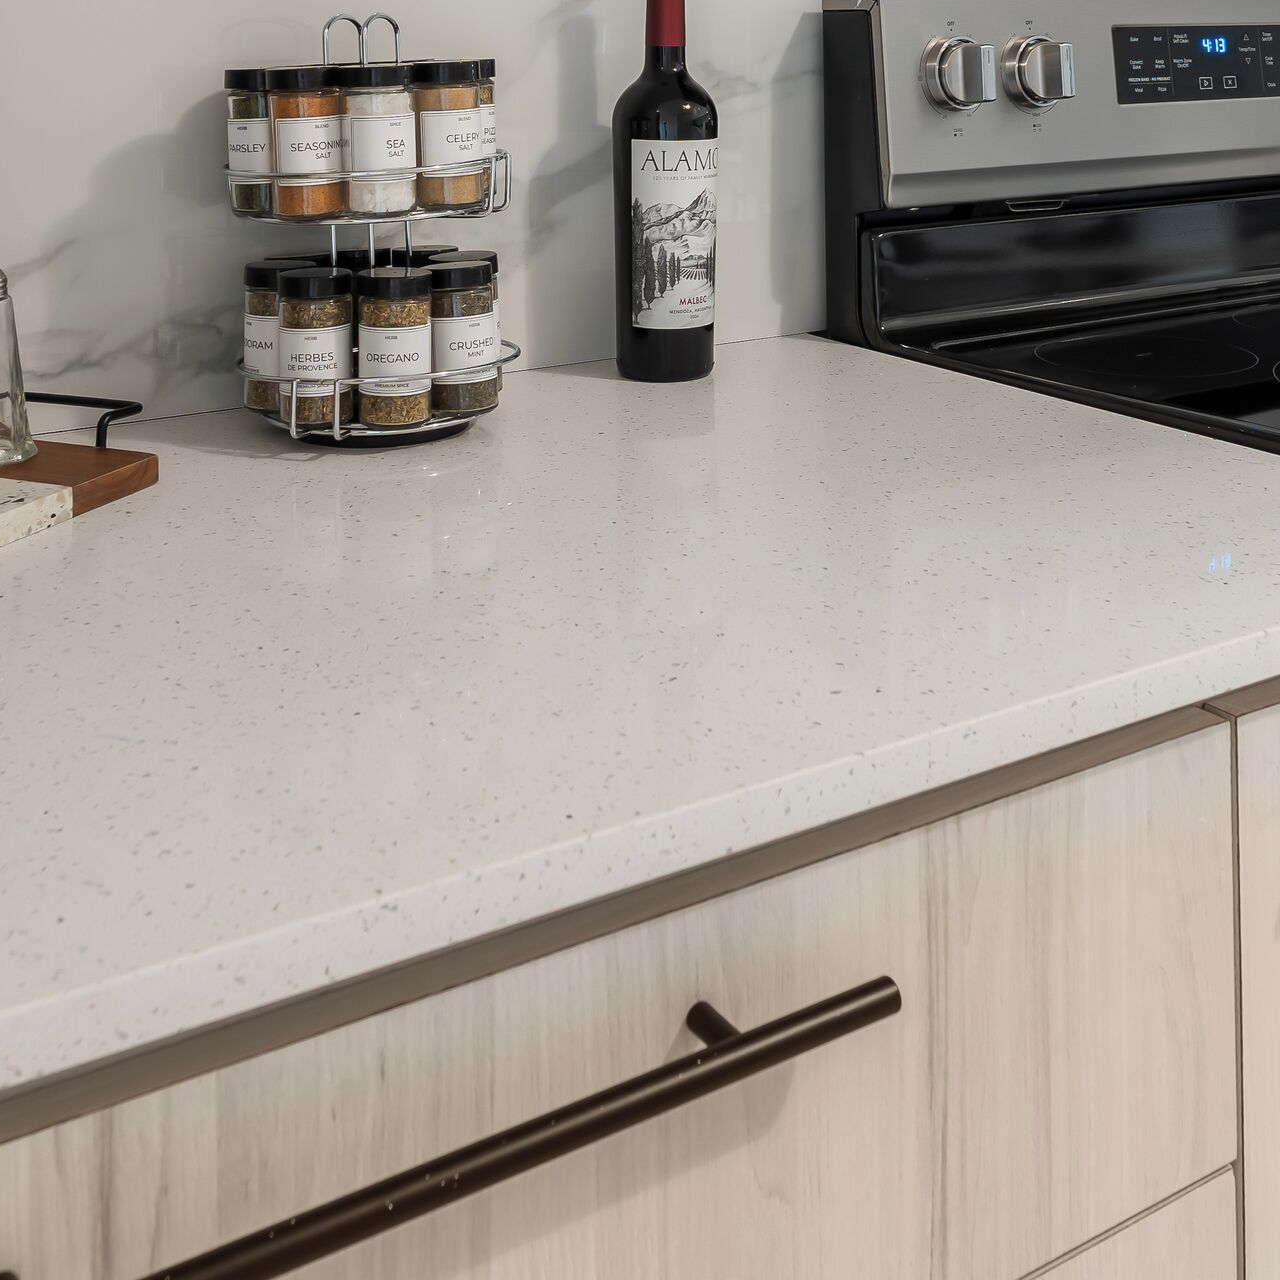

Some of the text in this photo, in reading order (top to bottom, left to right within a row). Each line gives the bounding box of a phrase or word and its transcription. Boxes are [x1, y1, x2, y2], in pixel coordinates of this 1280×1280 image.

[1202, 38, 1226, 53] 4:13
[446, 132, 480, 144] CELERY
[229, 143, 266, 153] PARSLEY
[386, 139, 406, 149] SEA
[315, 152, 332, 160] SALT
[679, 295, 708, 305] MALBEC
[449, 336, 494, 351] CRUSHED
[290, 351, 334, 363] HERBES
[366, 352, 420, 363] OREGANO
[467, 350, 485, 358] MINT
[297, 362, 338, 372] PROVENCE
